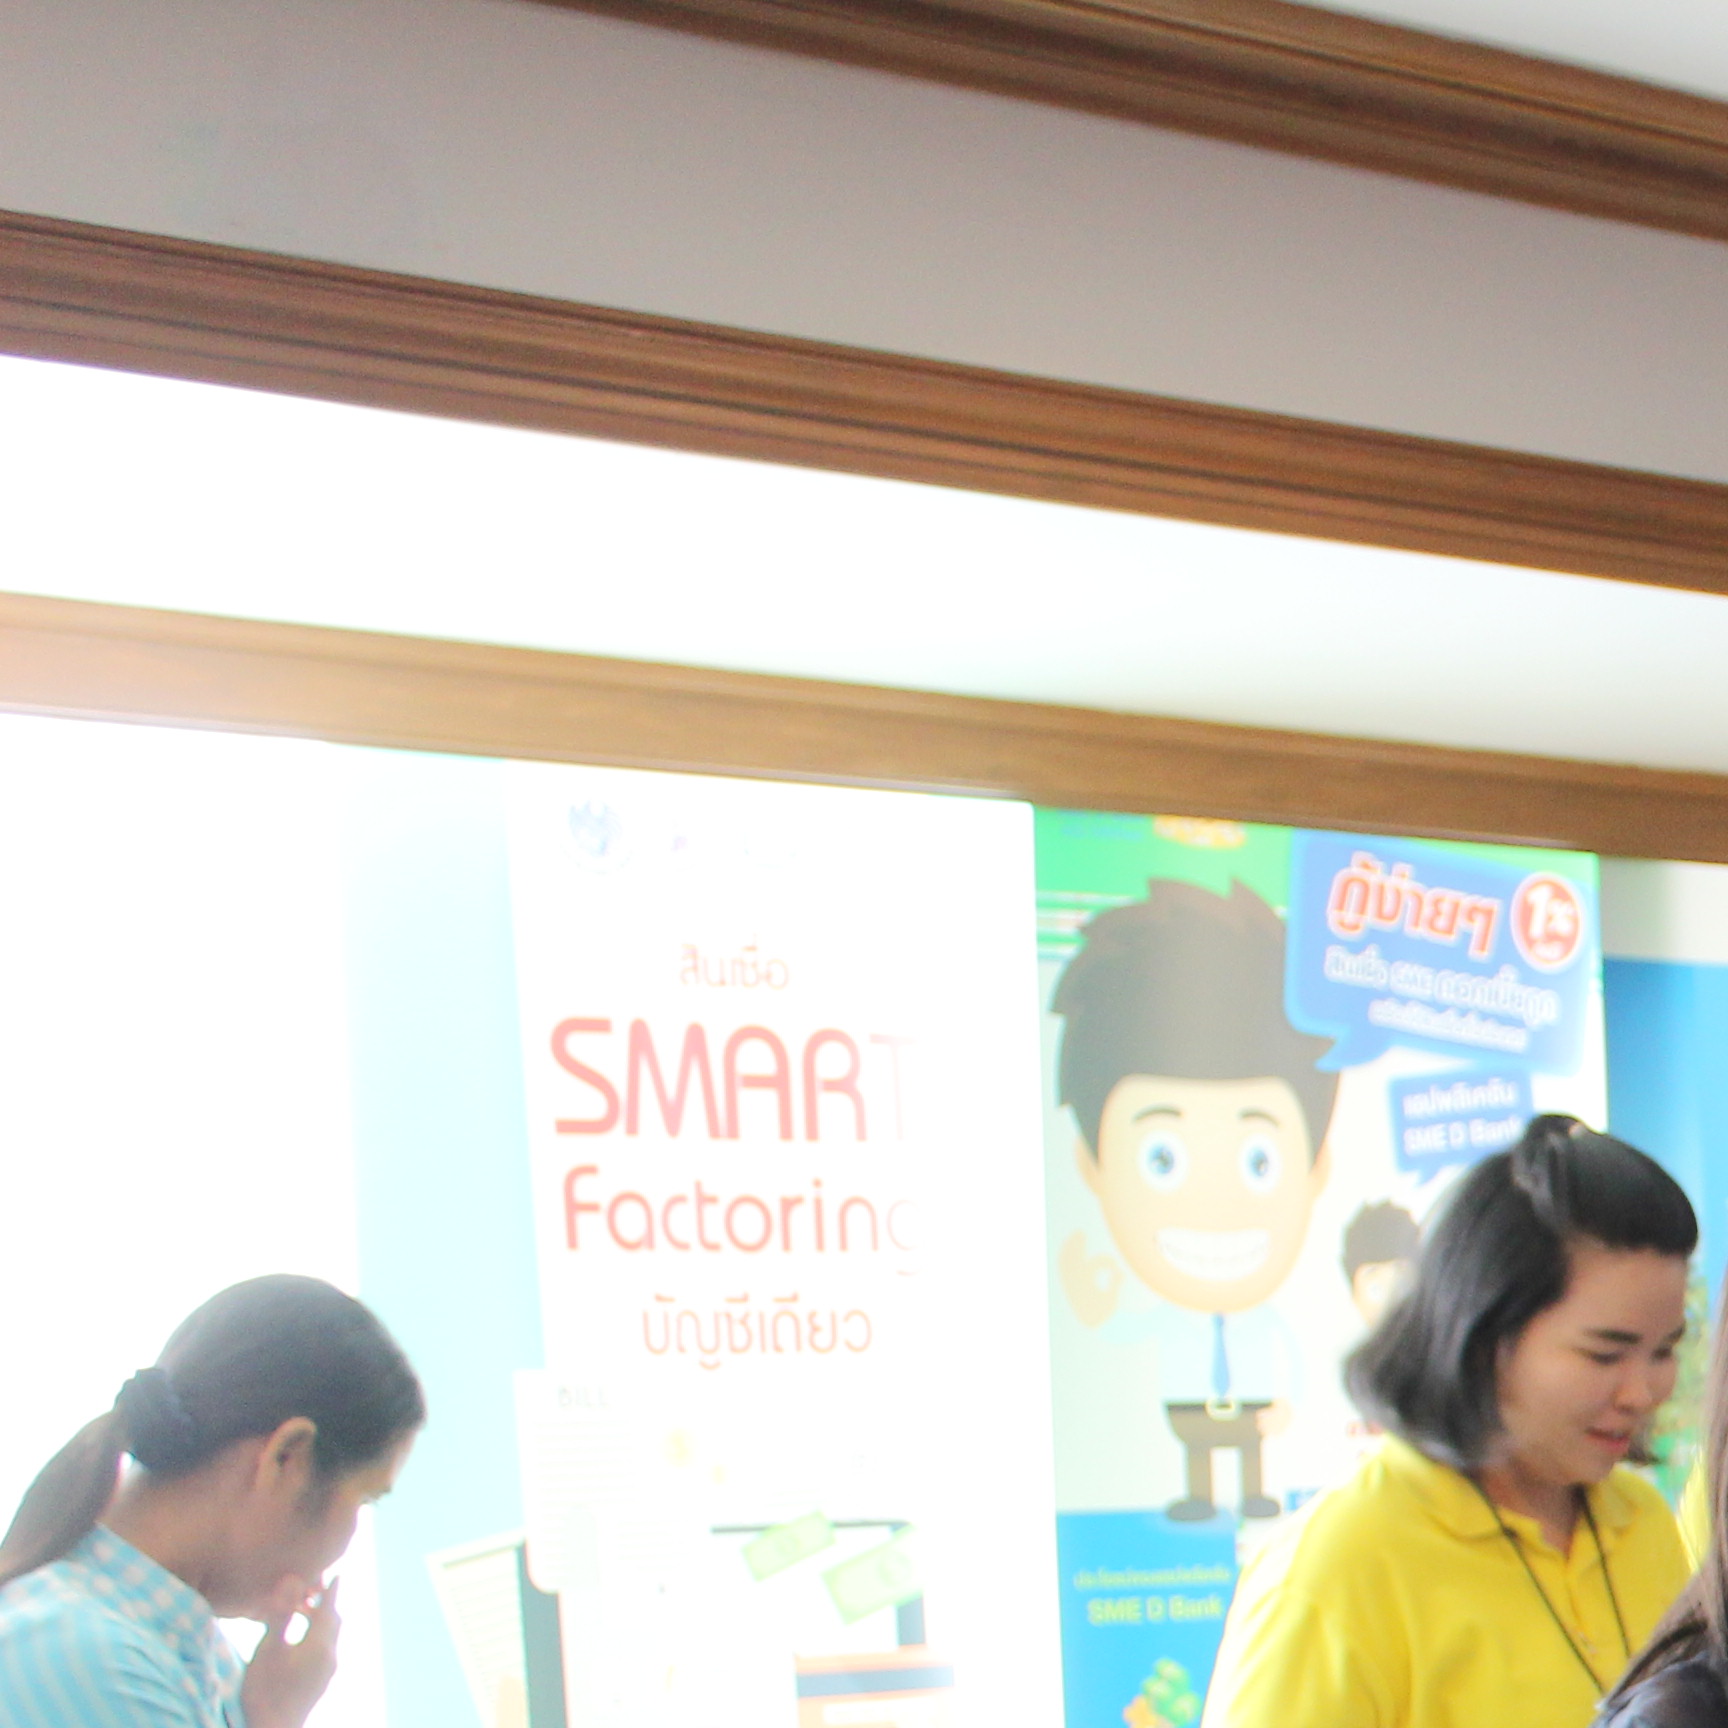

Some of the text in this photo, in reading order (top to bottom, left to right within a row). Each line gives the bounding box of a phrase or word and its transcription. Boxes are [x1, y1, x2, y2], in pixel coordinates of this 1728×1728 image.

[678, 933, 791, 990] สินเชื่อ
[549, 1014, 919, 1143] SMART
[640, 1290, 874, 1373] บัญชีเดียว
